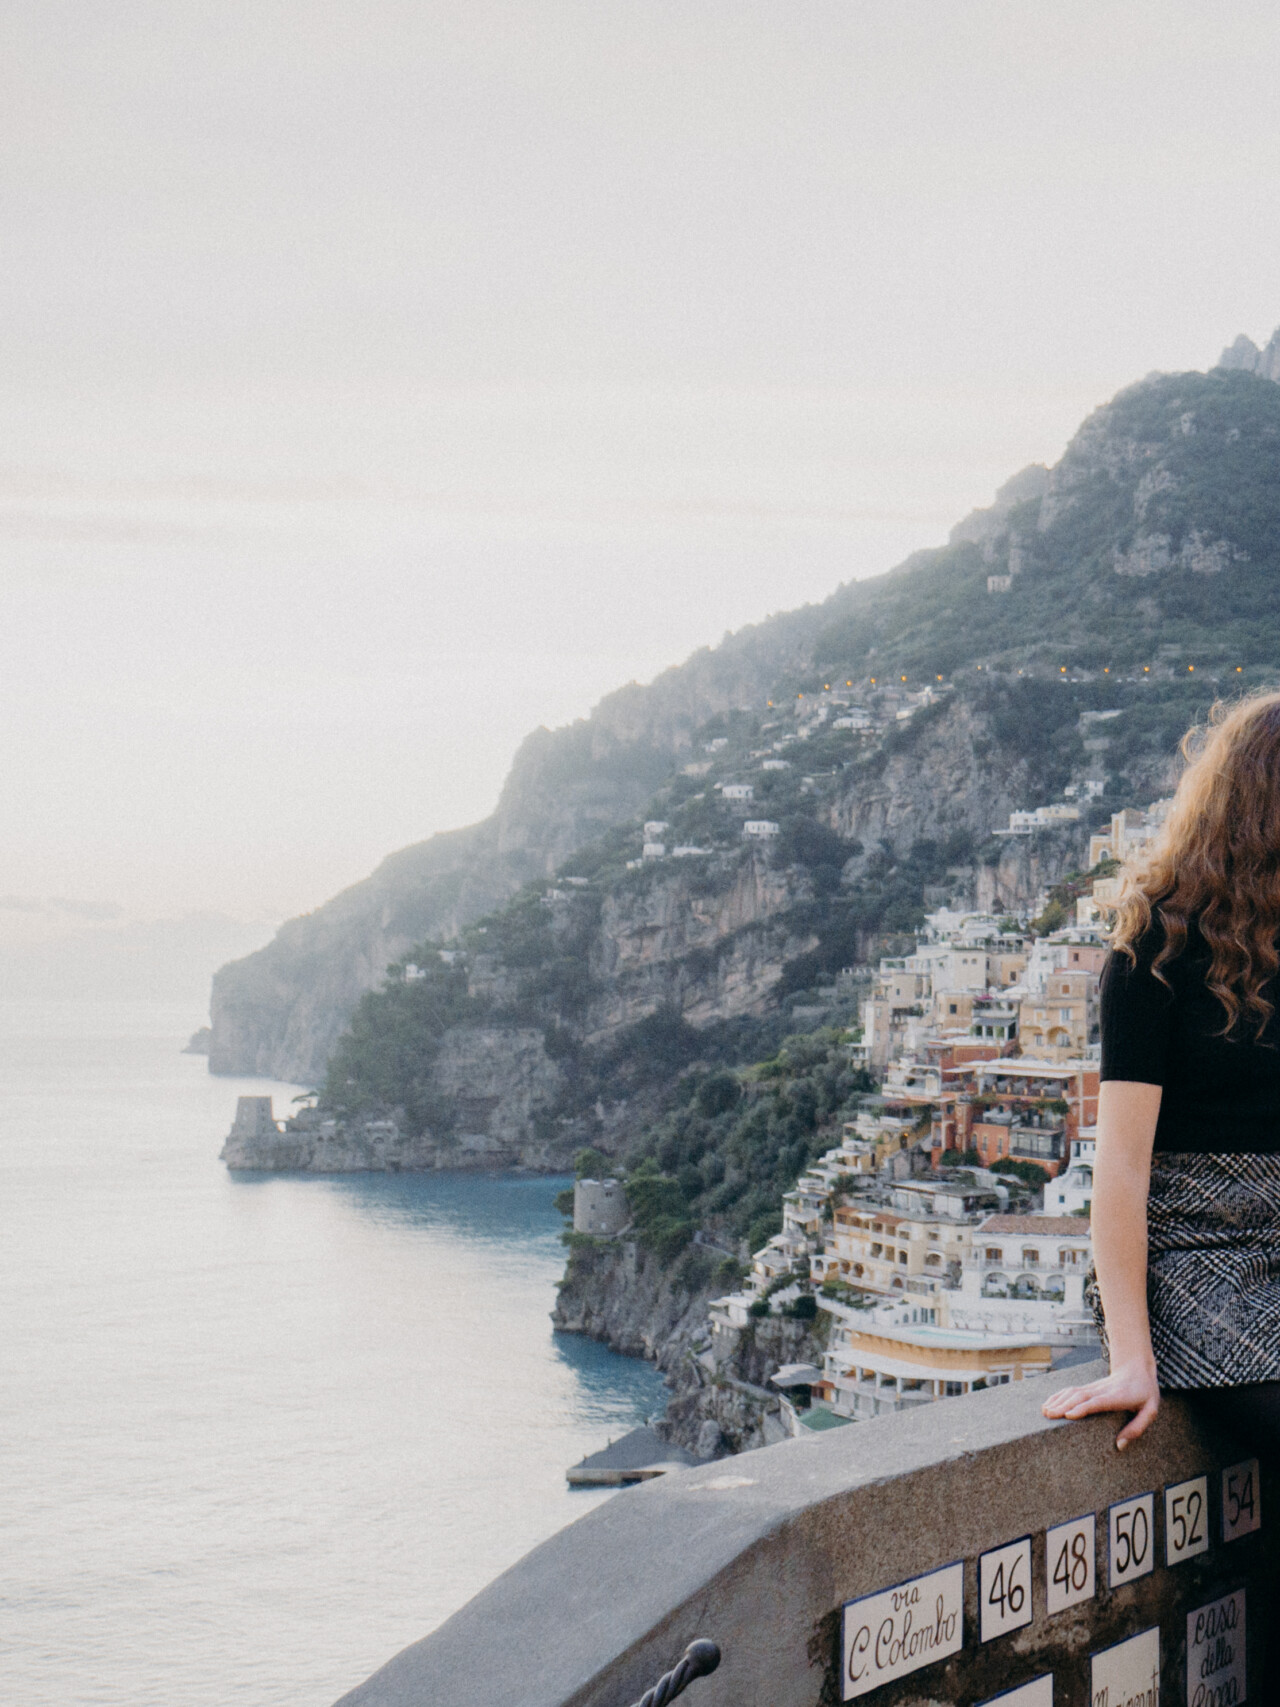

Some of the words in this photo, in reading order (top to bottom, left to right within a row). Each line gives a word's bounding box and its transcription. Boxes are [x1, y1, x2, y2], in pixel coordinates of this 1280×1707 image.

[1171, 1490, 1203, 1551] 52
[1227, 1470, 1255, 1527] 54
[1052, 1532, 1088, 1594] 48
[1115, 1506, 1149, 1574] 50
[891, 1585, 921, 1612] via
[988, 1553, 1025, 1619] 46
[848, 1625, 871, 1682] C.
[875, 1593, 958, 1669] Colombo
[1200, 1636, 1235, 1678] della
